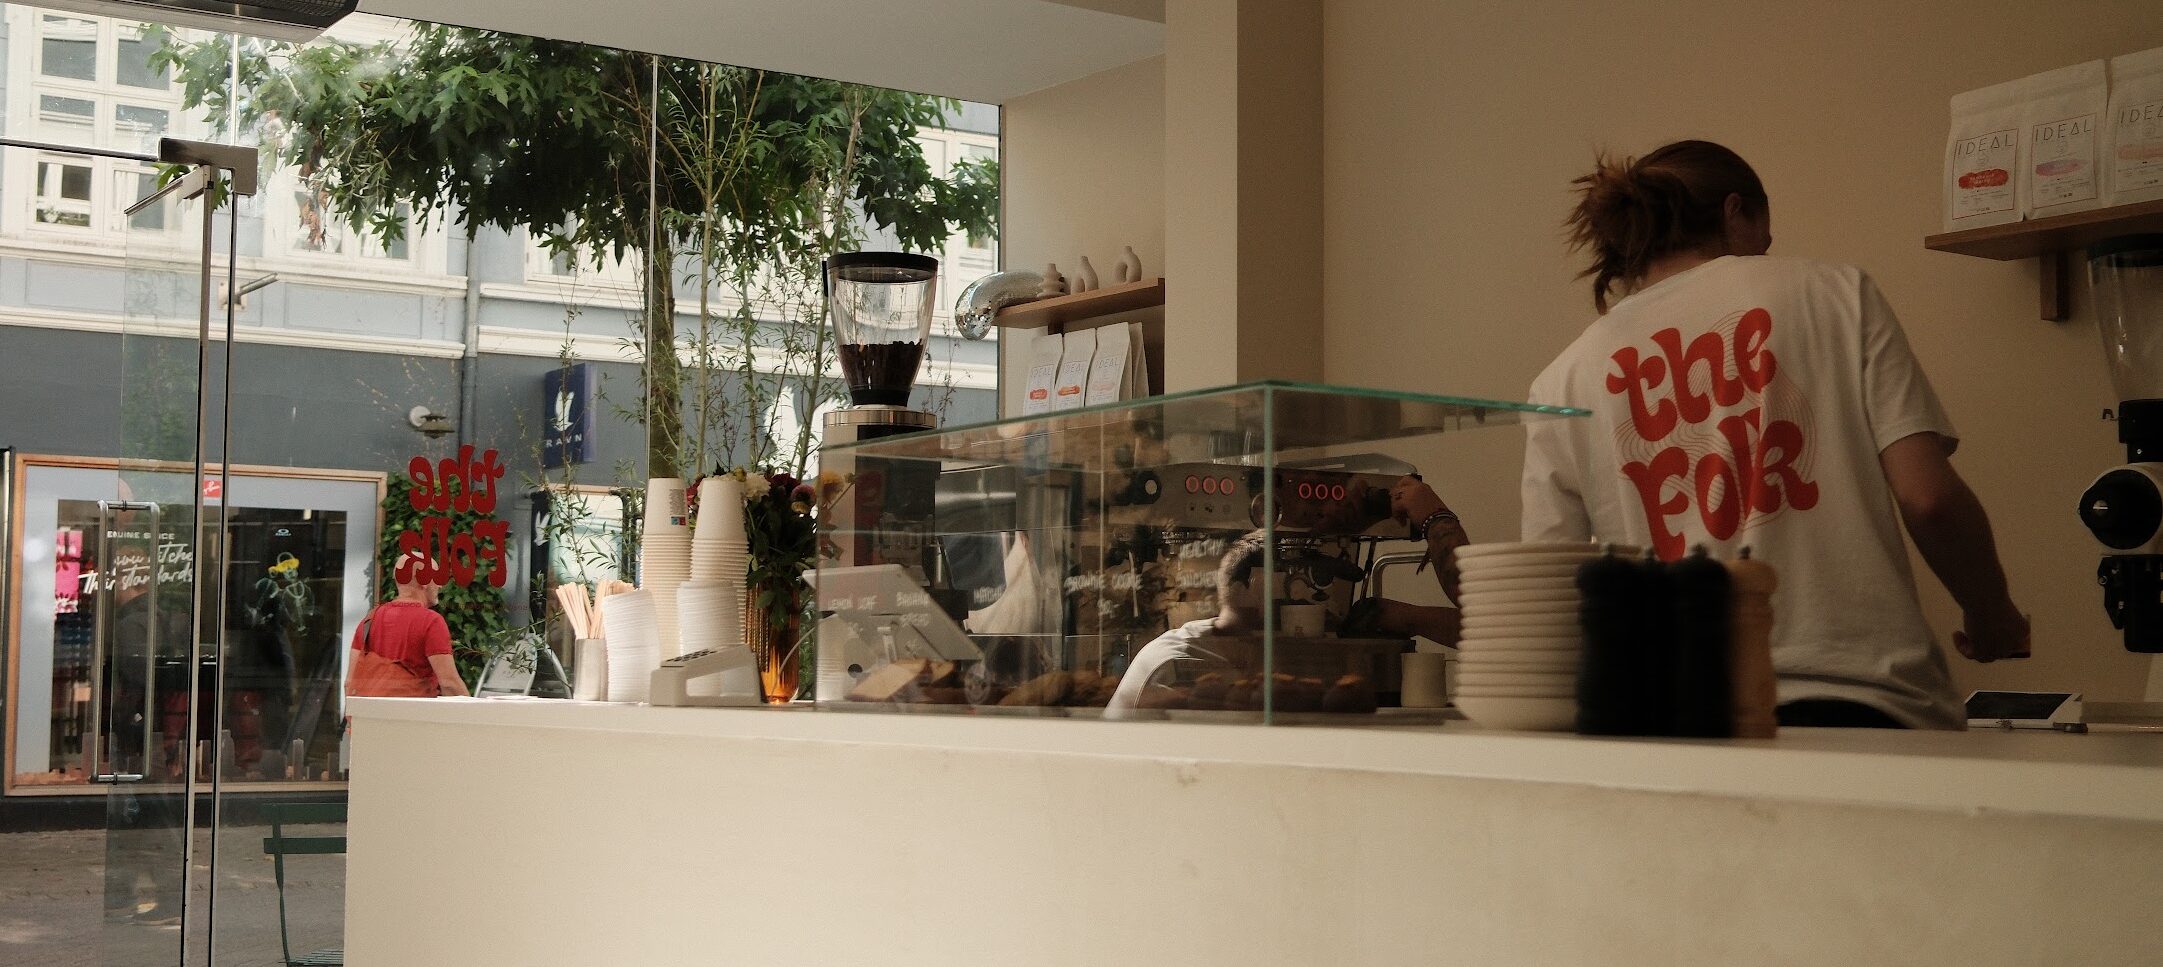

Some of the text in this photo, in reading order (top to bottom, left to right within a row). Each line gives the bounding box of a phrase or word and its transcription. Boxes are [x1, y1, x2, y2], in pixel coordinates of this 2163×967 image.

[2034, 119, 2092, 143] IDEAL
[1957, 133, 2015, 156] IDEAL
[1606, 307, 1777, 442] the
[545, 433, 583, 448] RAVN
[106, 530, 175, 540] ENUINE SCE
[77, 569, 116, 594] Thir
